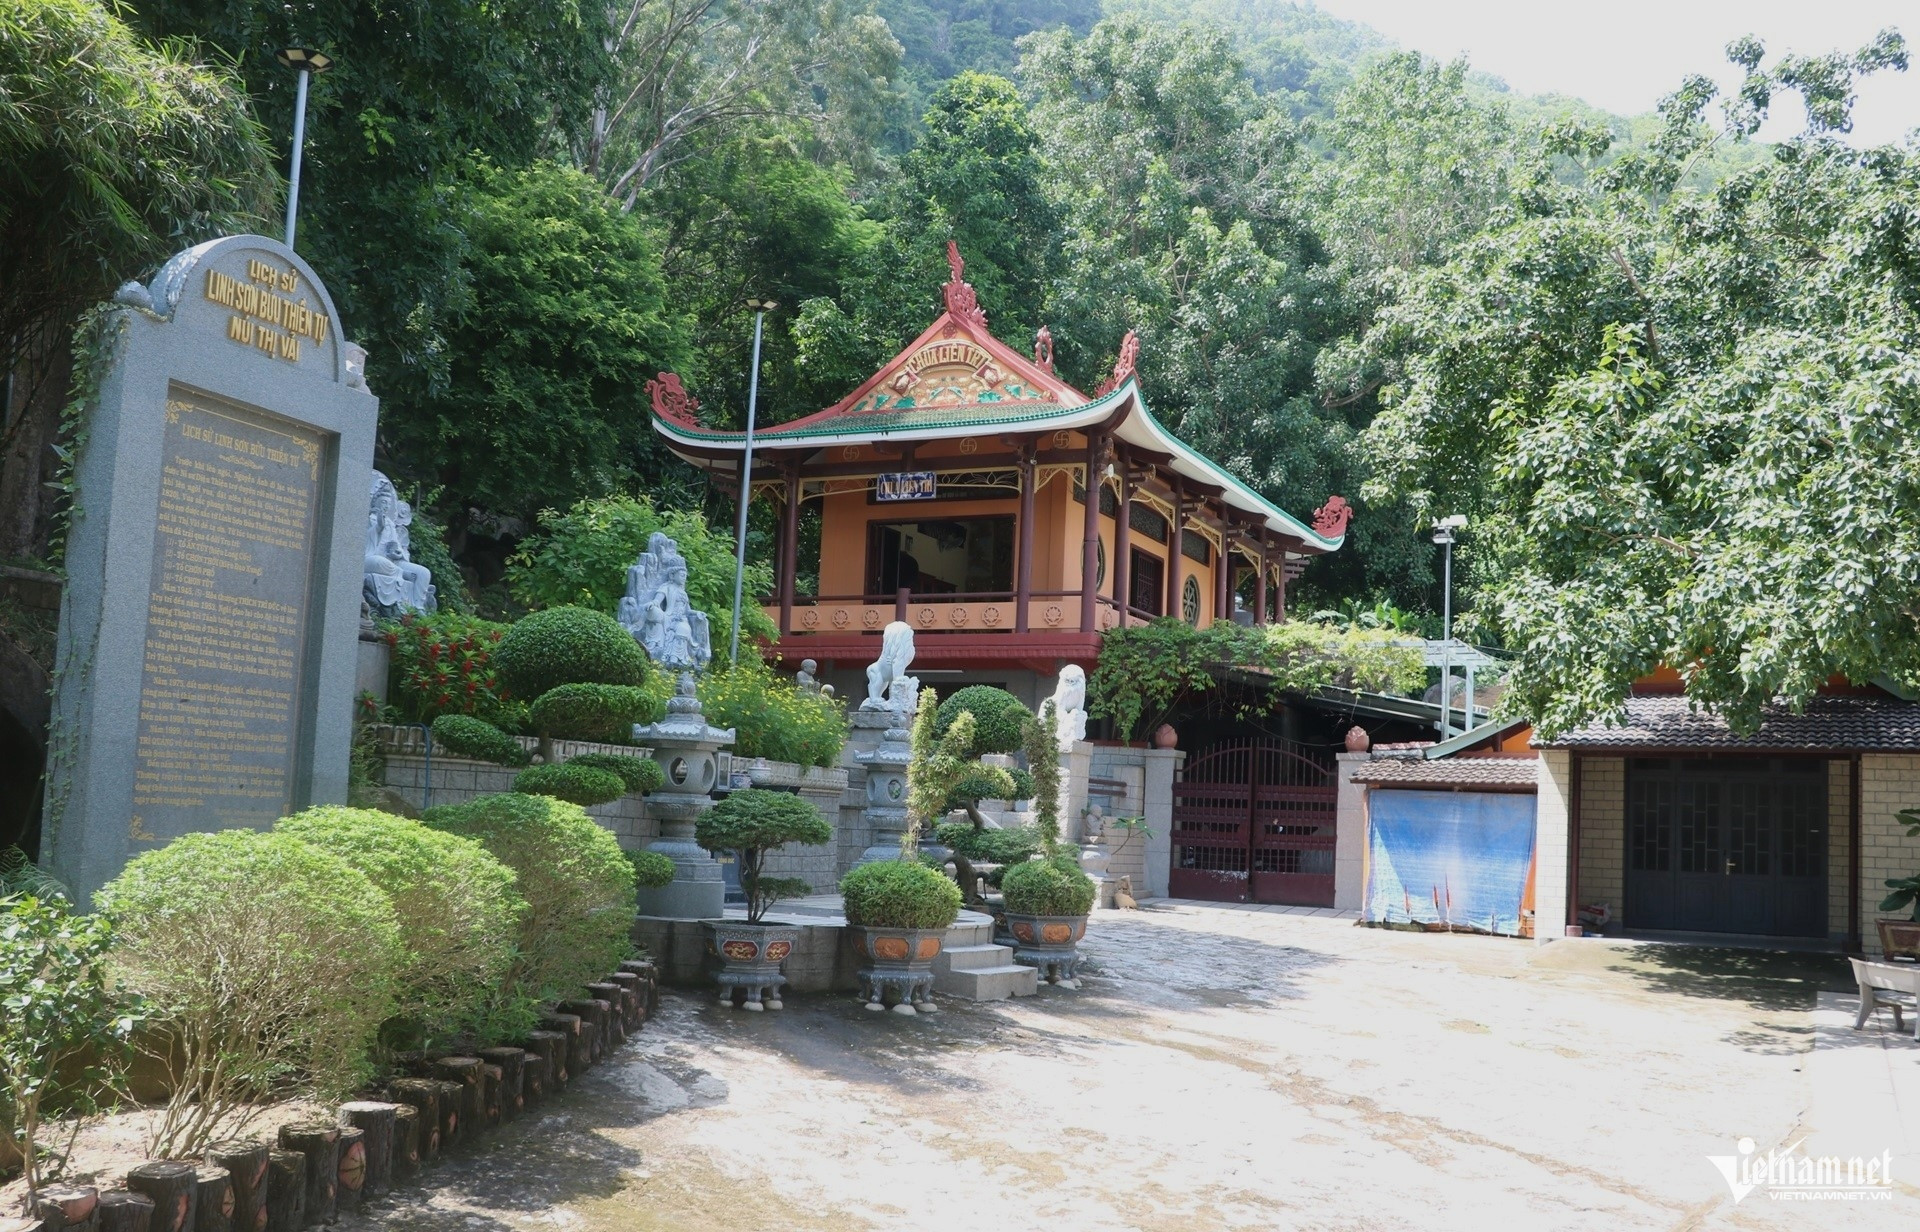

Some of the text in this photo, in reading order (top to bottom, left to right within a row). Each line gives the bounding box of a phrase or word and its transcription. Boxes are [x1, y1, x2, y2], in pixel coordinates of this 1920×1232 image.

[250, 259, 299, 293] LỊCH SỬ
[207, 269, 235, 307] LINH
[235, 281, 259, 315] SƠN
[283, 298, 313, 336] THIỀN
[314, 312, 329, 347] TỰ
[231, 315, 300, 361] NÚI THỊ VẢI
[939, 342, 966, 362] LIÊN
[182, 425, 200, 441] LỊCH
[202, 426, 214, 443] SỬ
[214, 433, 232, 448] LINH
[234, 438, 248, 453] SƠN
